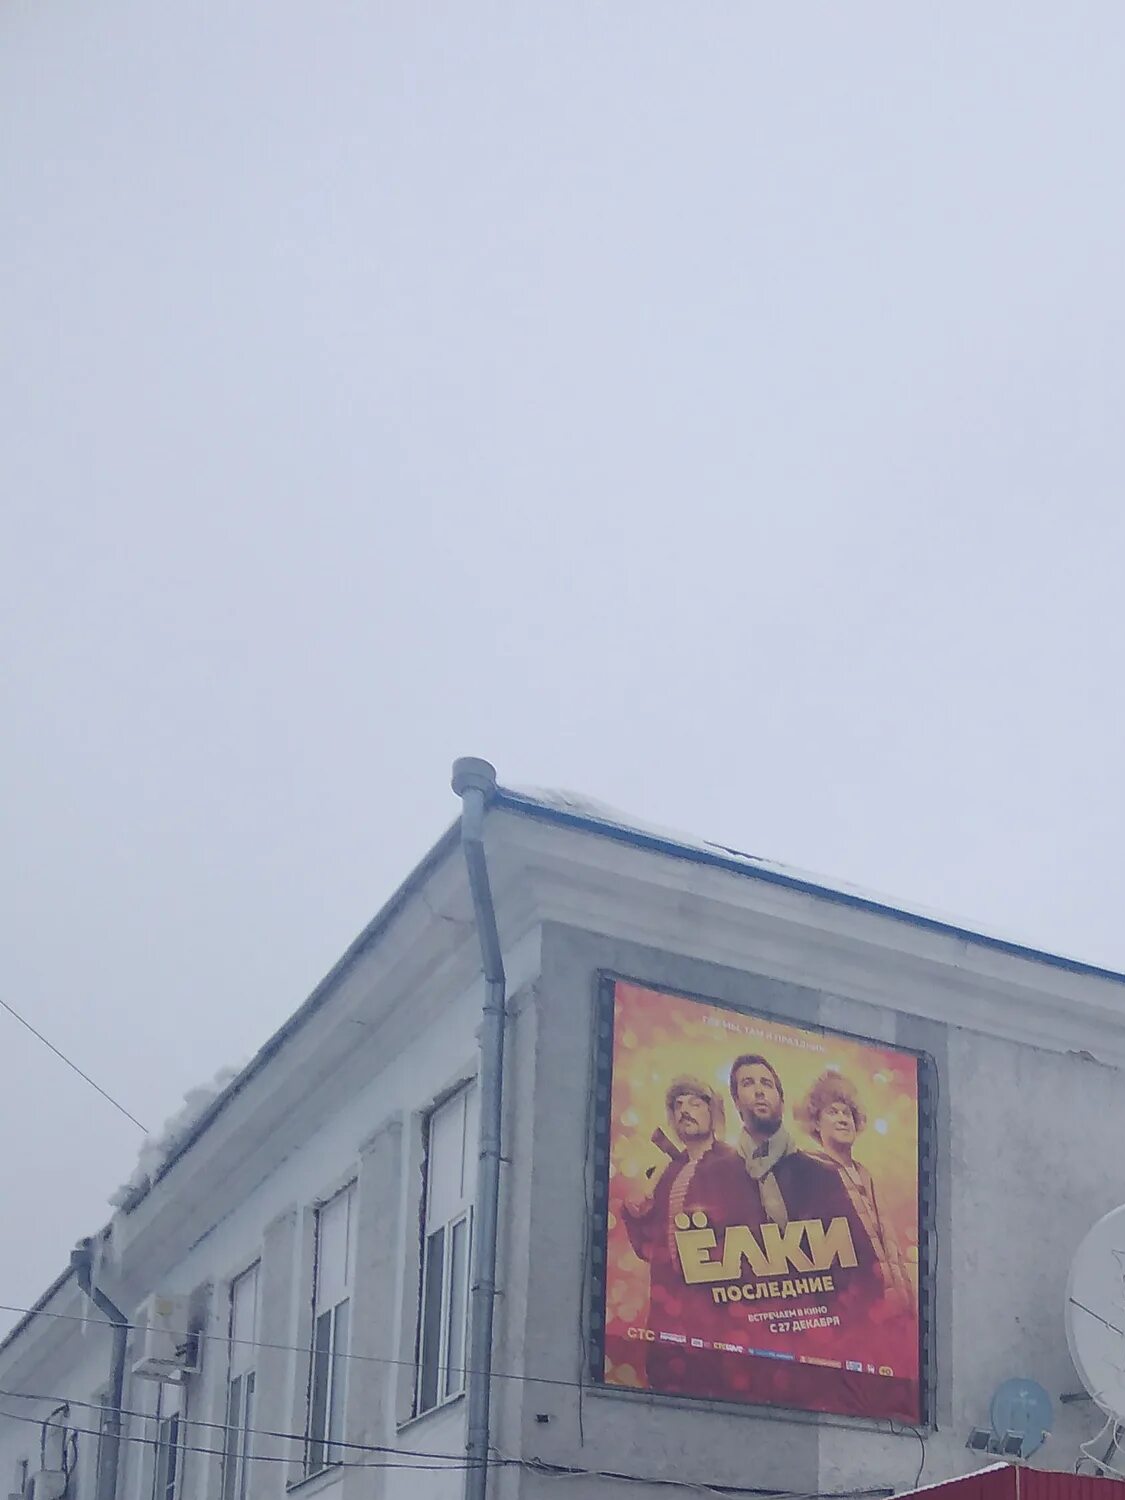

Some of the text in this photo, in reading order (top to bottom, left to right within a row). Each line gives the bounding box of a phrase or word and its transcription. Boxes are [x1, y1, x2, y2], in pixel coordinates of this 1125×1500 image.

[674, 1211, 859, 1284] ЁЛКИ
[711, 1275, 835, 1303] ПОСЛЕДНИЕ
[747, 1309, 797, 1322] ВСТРЕЧАЕМ
[804, 1305, 828, 1315] КИНО
[770, 1315, 840, 1333] С 27 ДЕКАБРЯ
[627, 1327, 655, 1341] СТС
